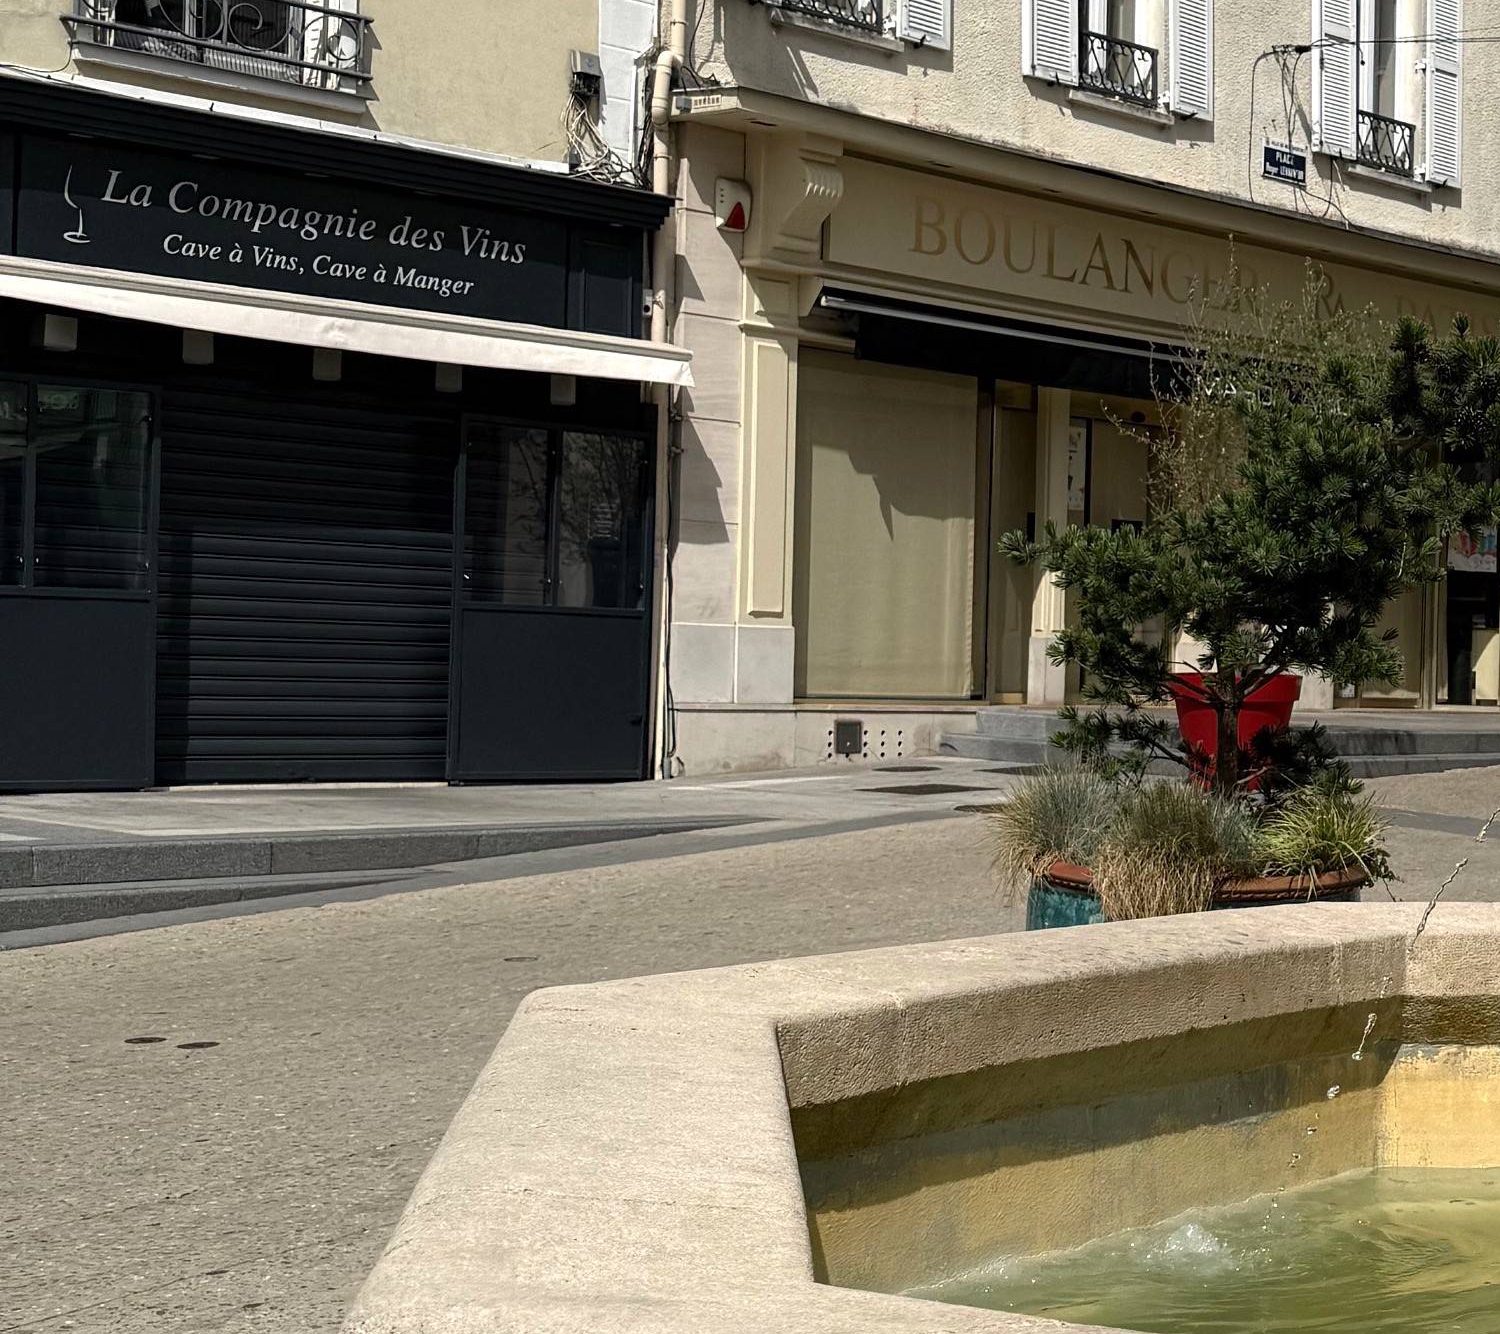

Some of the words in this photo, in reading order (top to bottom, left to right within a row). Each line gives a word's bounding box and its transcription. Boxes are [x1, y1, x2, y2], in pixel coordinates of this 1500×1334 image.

[101, 169, 153, 208] La
[168, 181, 377, 241] Compagnie
[388, 216, 445, 252] des
[459, 225, 526, 264] Vins
[163, 233, 222, 260] Cave
[228, 243, 243, 263] à
[252, 245, 305, 275] Vins,
[312, 255, 367, 280] Cave
[373, 263, 387, 284] à
[393, 266, 475, 297] Manger
